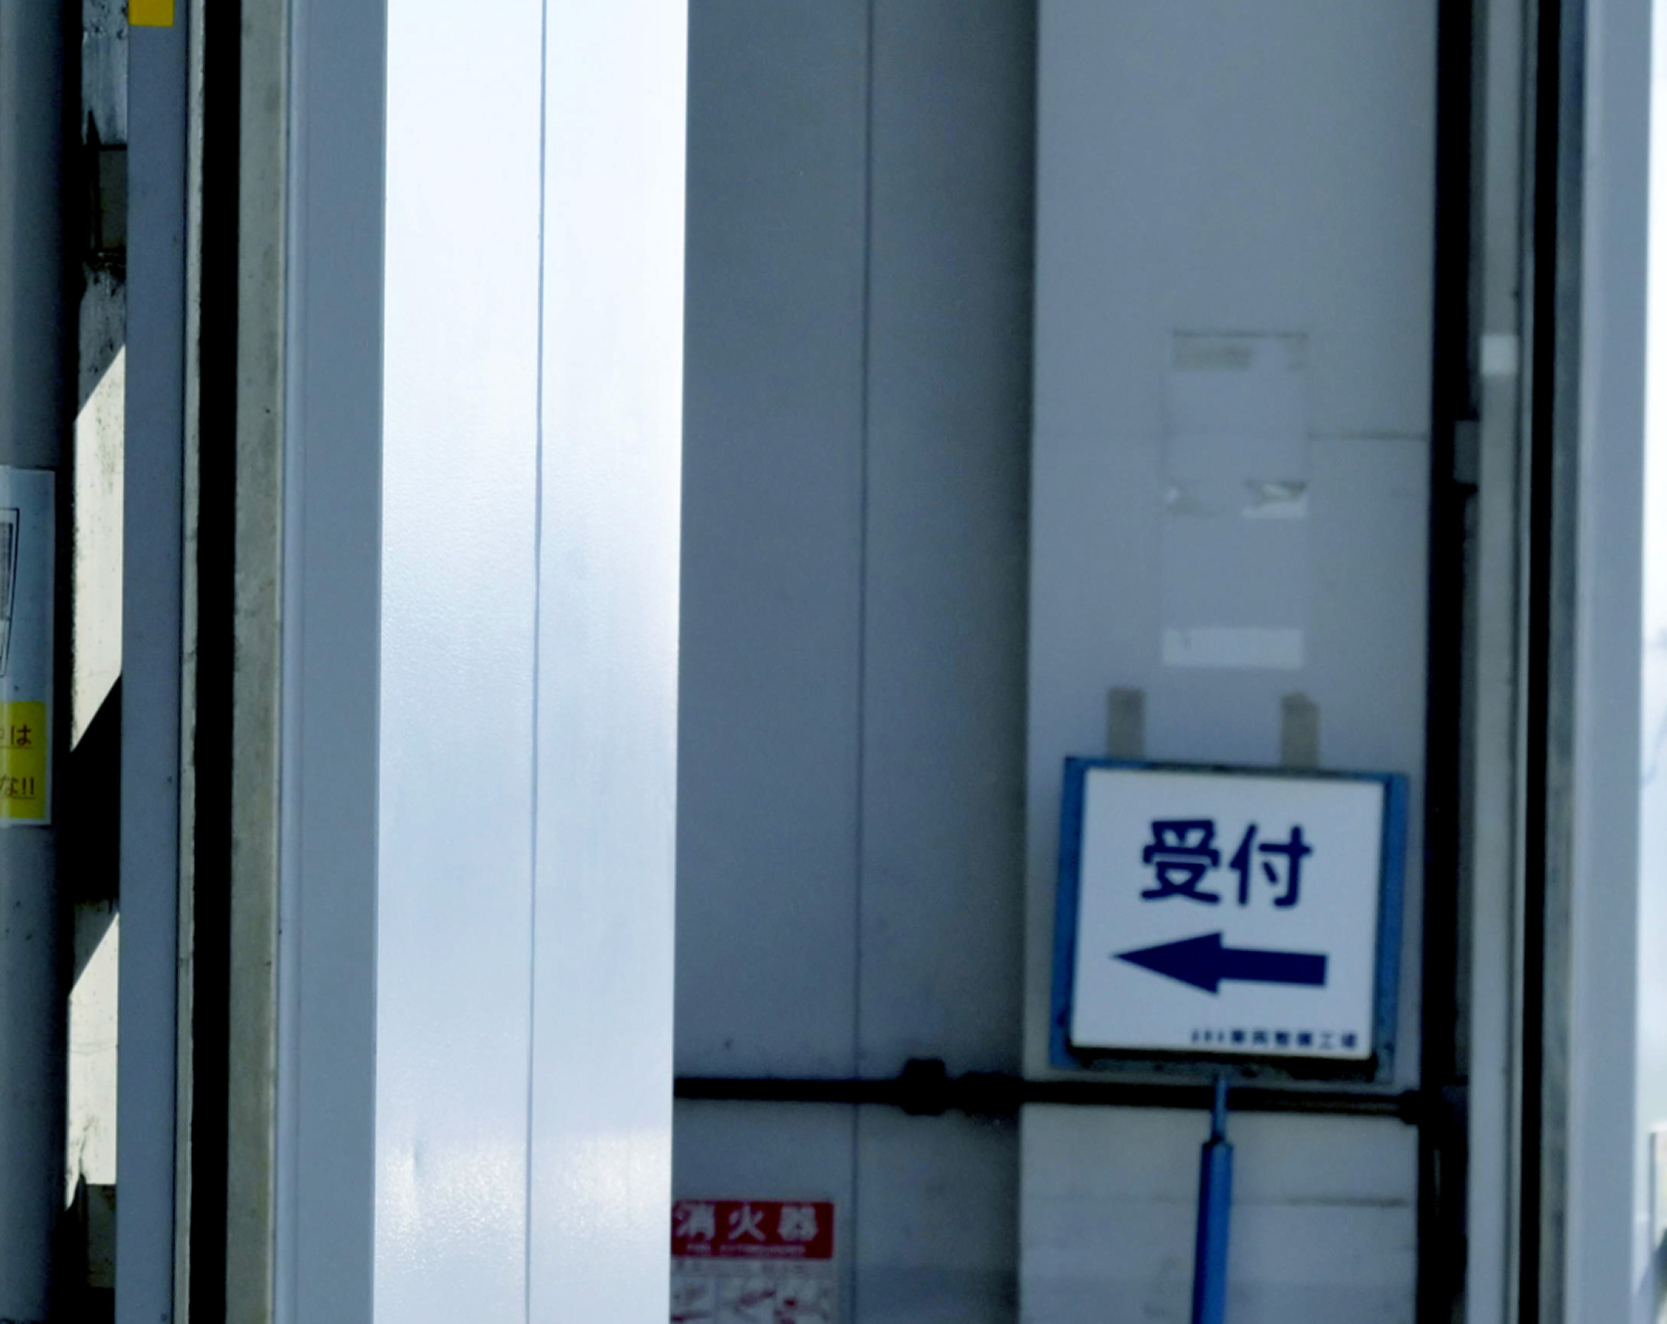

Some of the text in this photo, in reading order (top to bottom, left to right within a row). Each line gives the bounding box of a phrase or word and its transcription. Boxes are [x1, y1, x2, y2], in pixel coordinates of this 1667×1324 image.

[1140, 820, 1312, 907] 受付
[675, 1202, 819, 1243] 消火器
